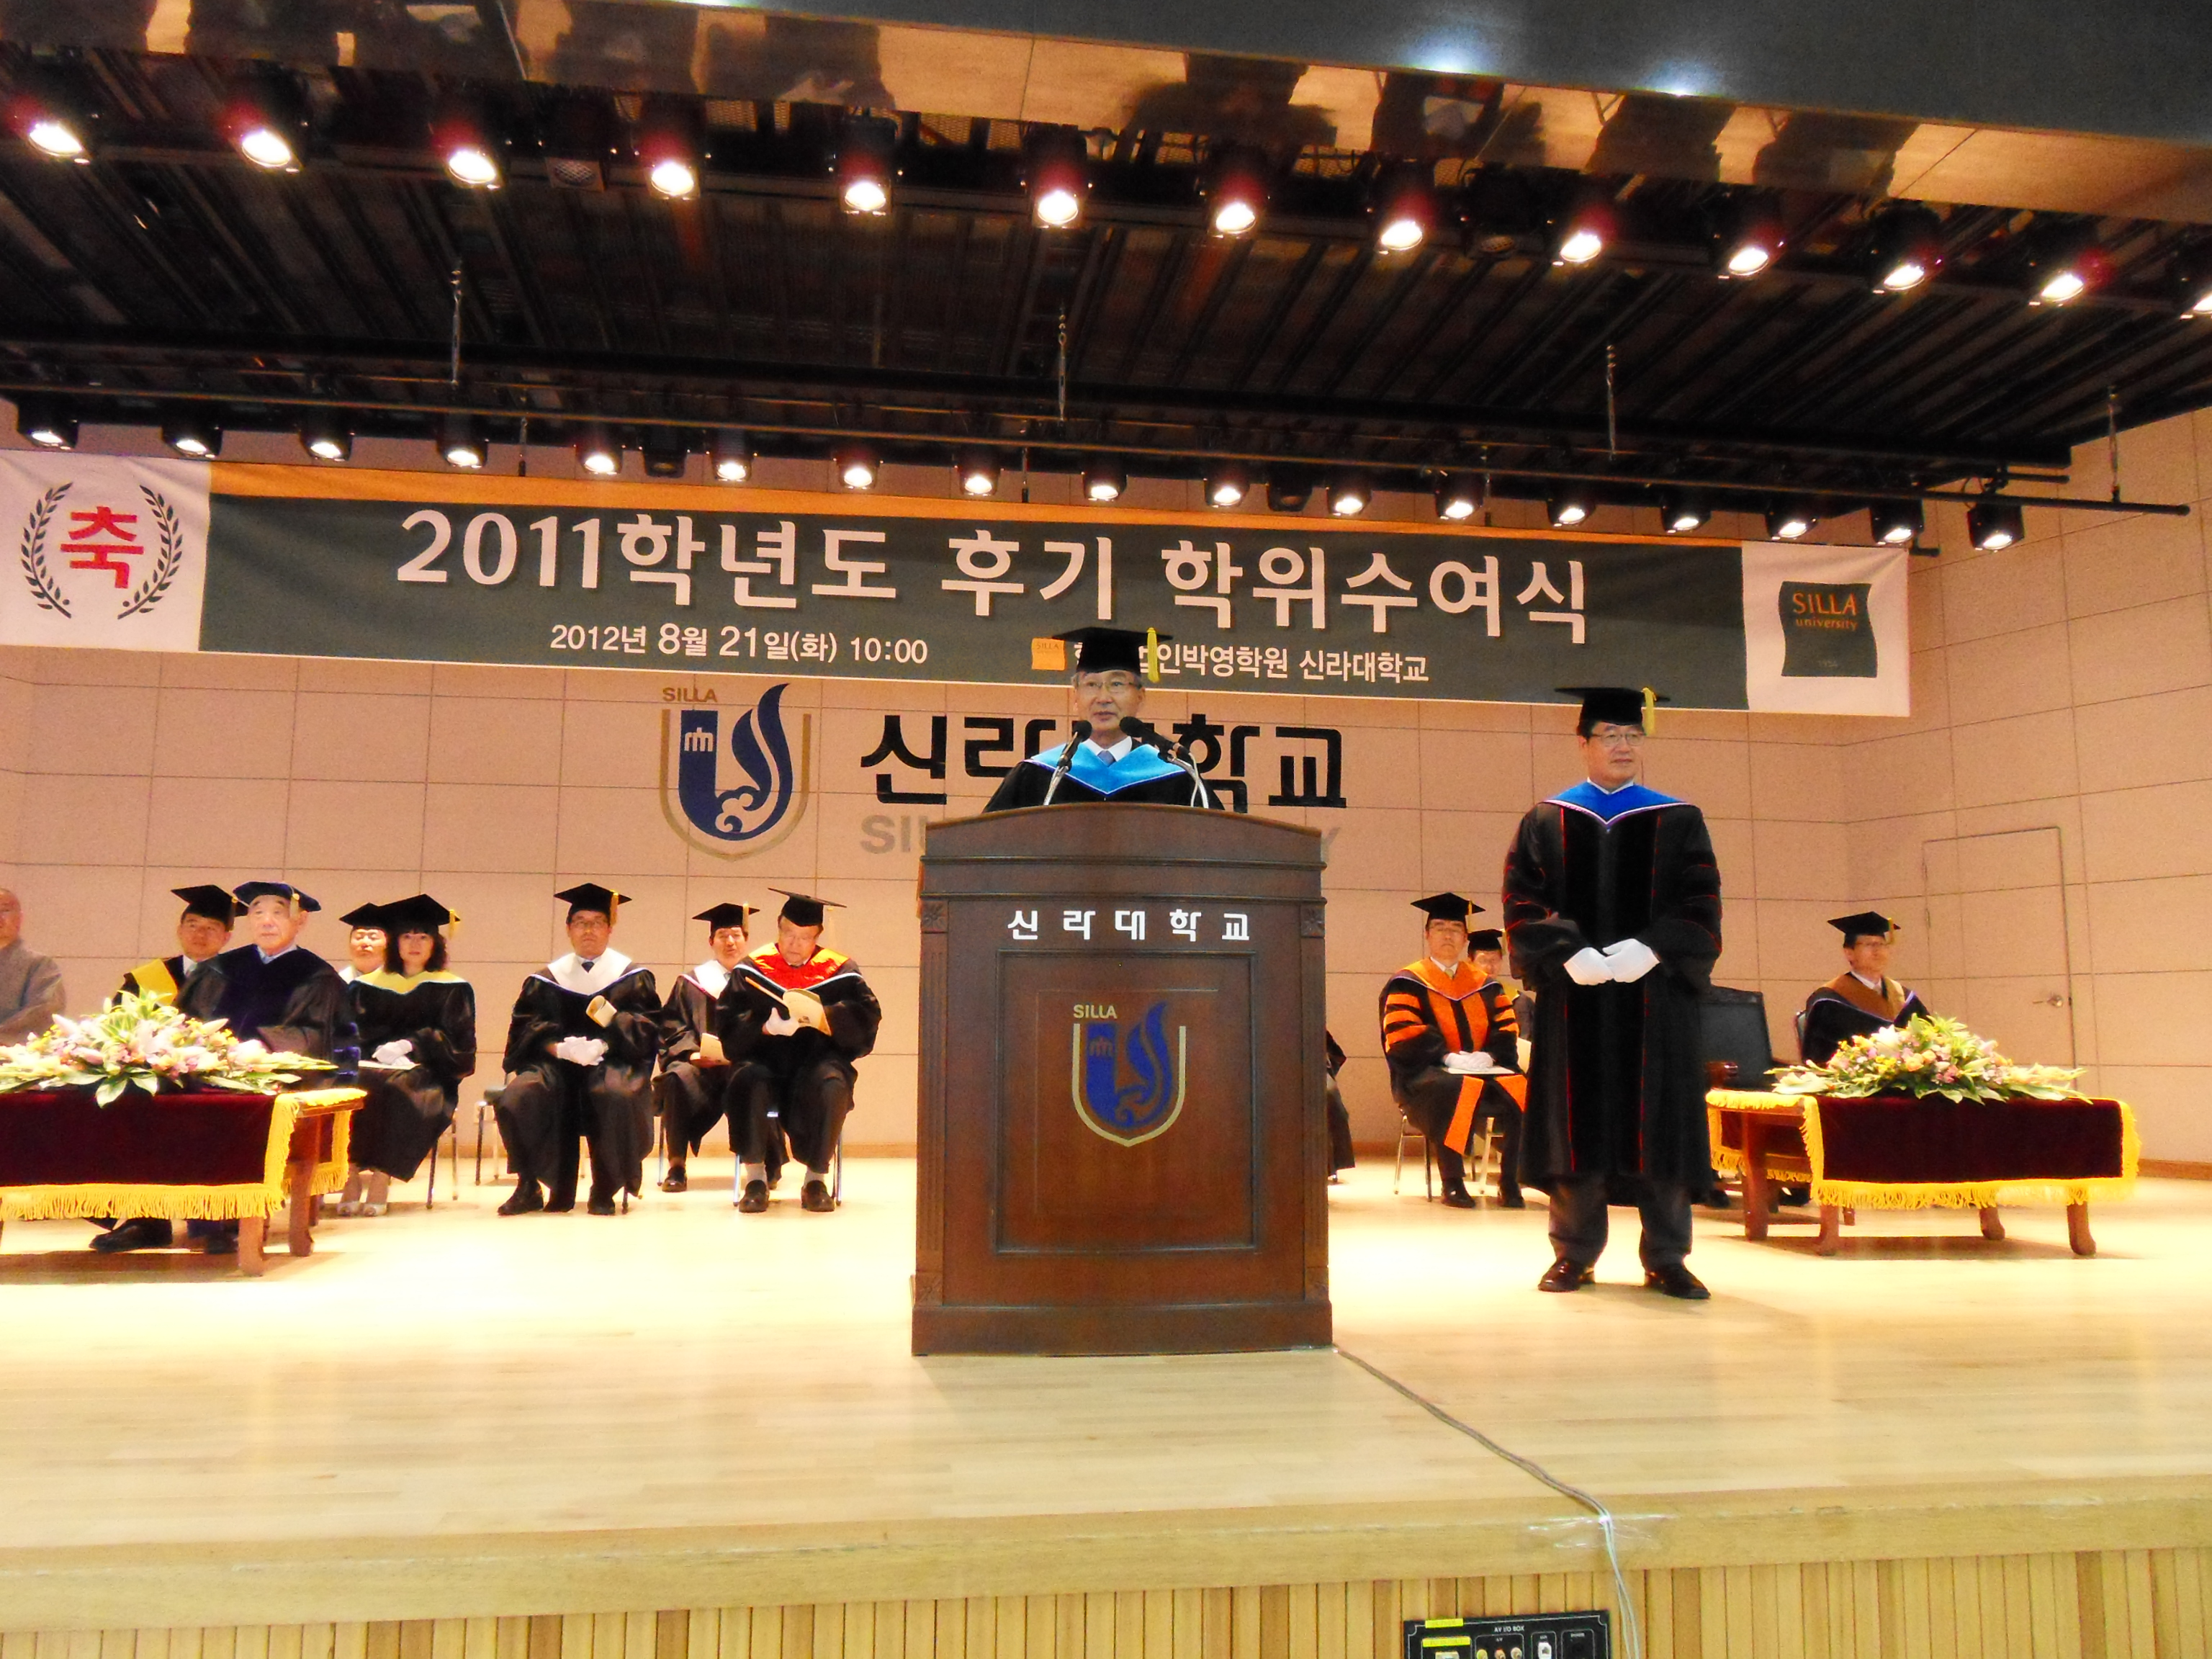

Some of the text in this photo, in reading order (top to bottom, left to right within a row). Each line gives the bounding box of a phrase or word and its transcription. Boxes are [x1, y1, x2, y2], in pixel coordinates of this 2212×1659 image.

[60, 505, 144, 589] 축
[397, 508, 1587, 645] 2011학년도 후기 학위수여식
[1792, 592, 1858, 616] SILLA
[1795, 619, 1858, 631] university
[550, 622, 927, 665] 2012년 8월 21일(화) 10:00
[1298, 652, 1429, 683] 신라대학교
[662, 687, 718, 703] SILLA
[860, 714, 1347, 814] 신라학교
[1073, 1004, 1118, 1020] SILLA
